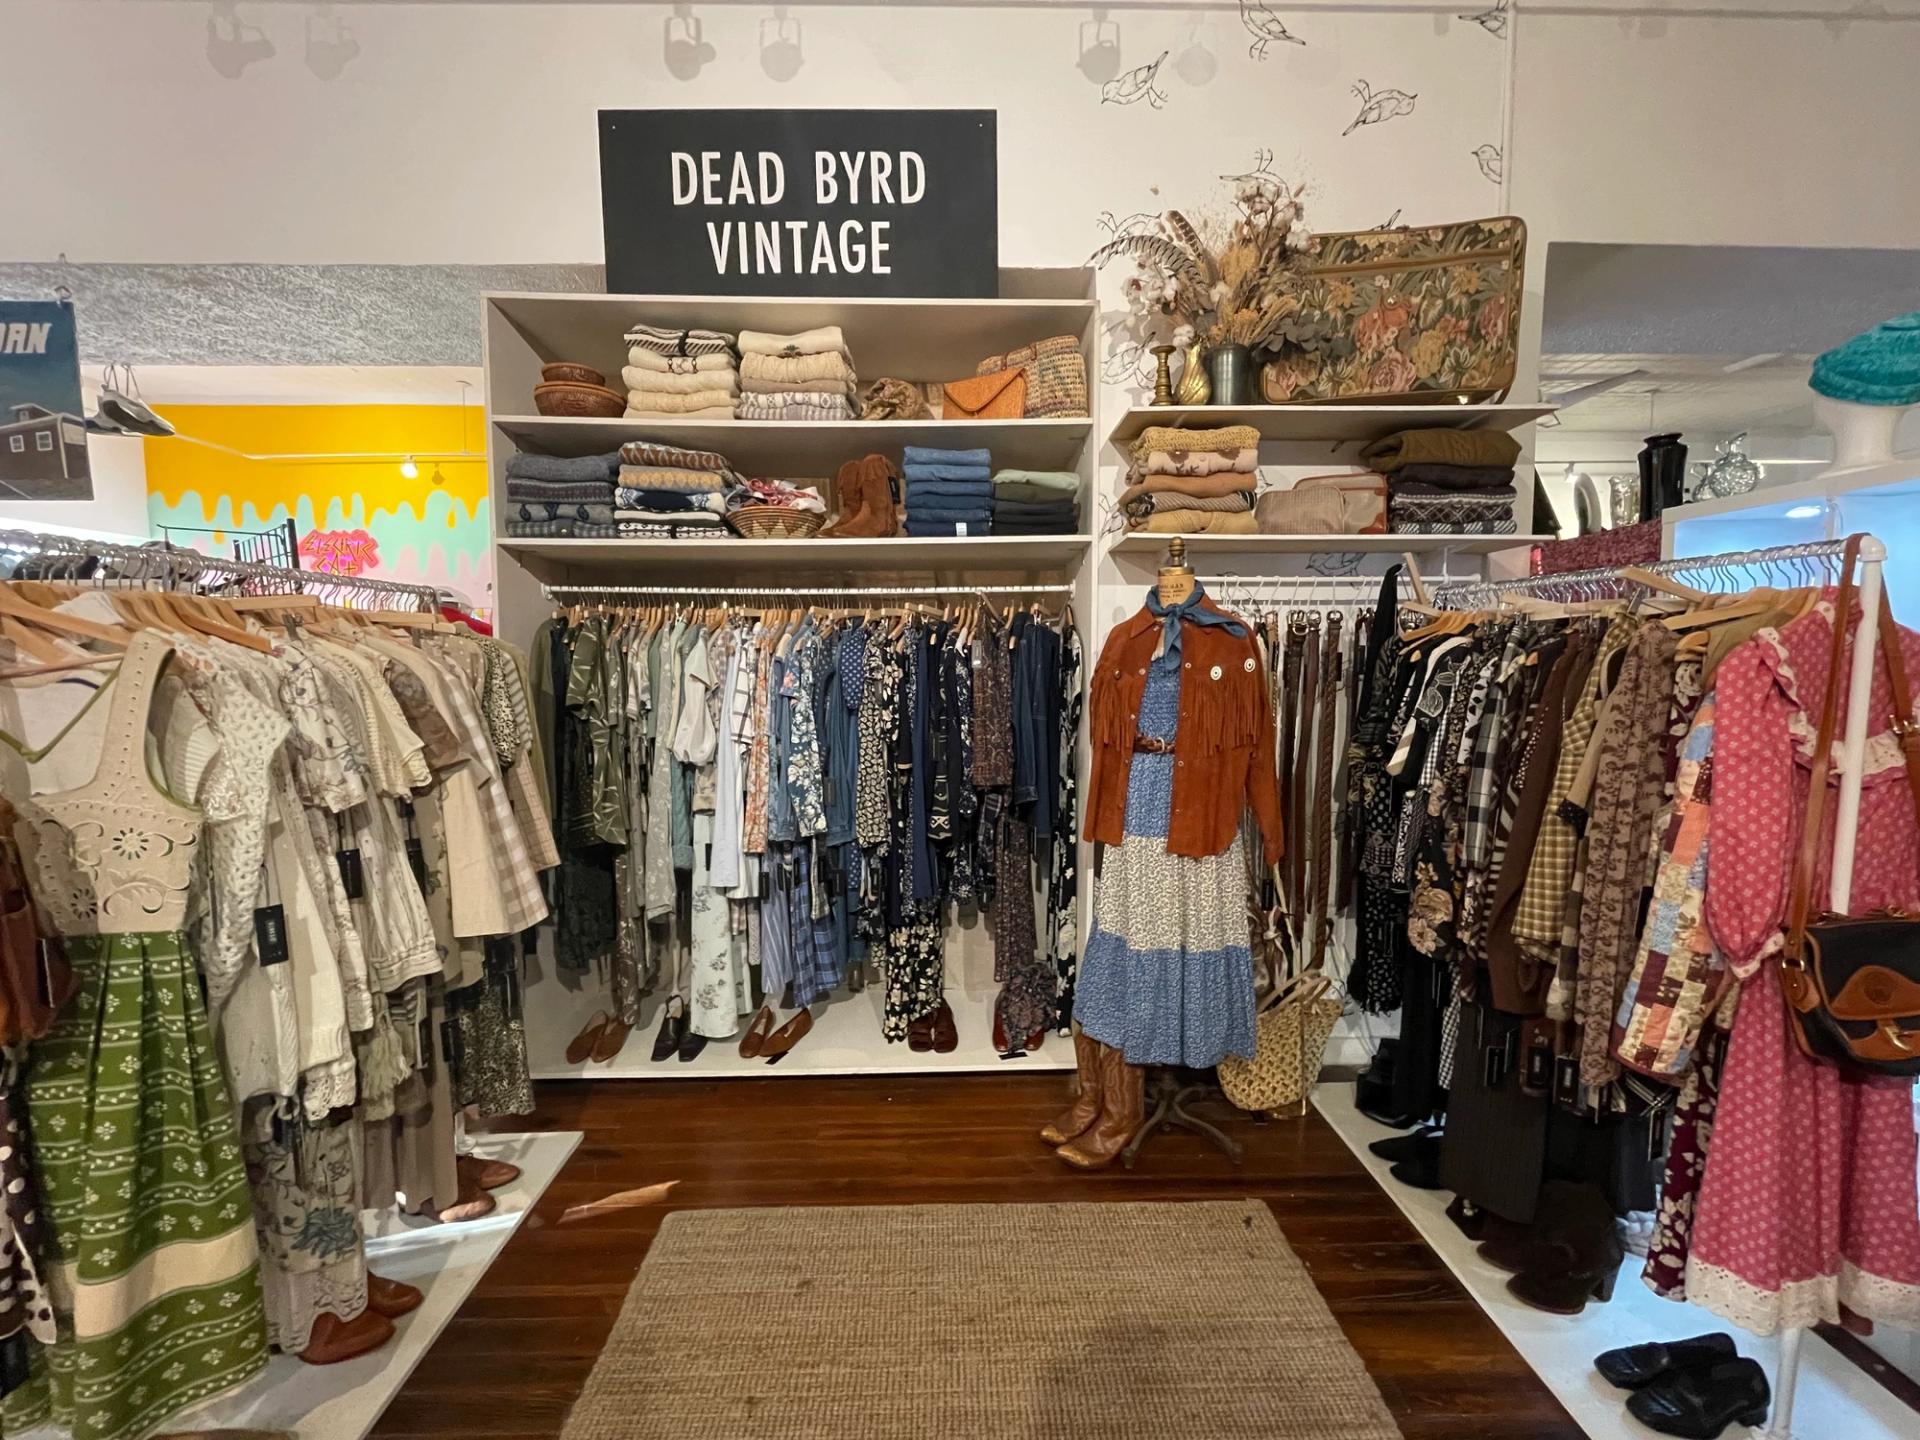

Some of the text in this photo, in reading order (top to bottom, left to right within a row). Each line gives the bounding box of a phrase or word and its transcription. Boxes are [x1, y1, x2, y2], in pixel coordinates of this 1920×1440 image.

[671, 151, 925, 205] DEAD BYRD
[706, 219, 891, 274] VINTAGE
